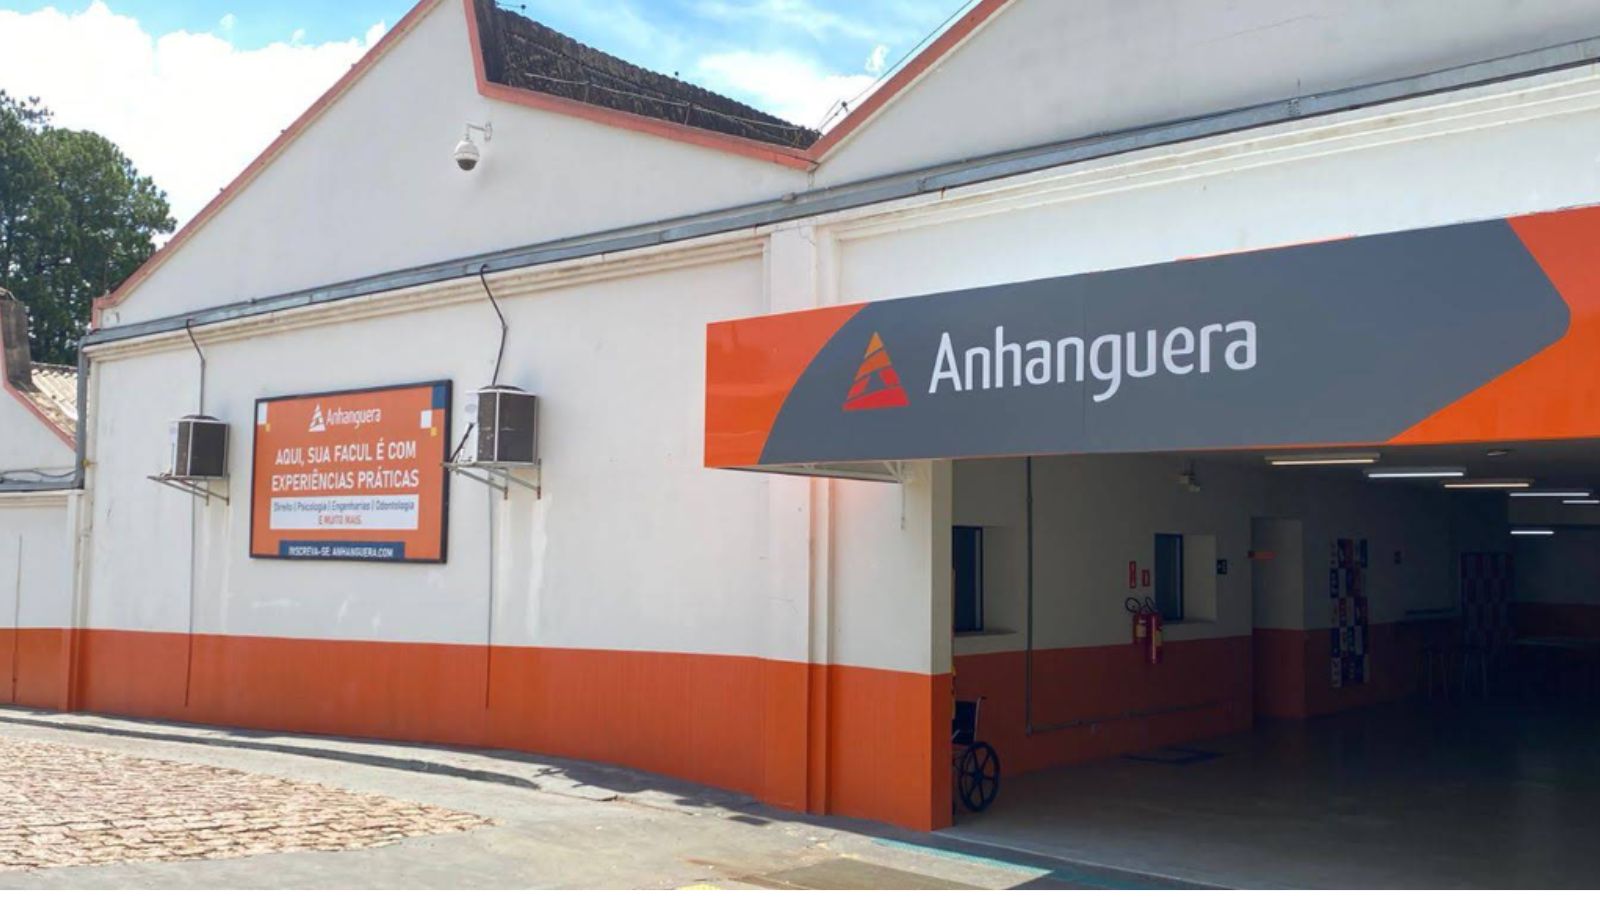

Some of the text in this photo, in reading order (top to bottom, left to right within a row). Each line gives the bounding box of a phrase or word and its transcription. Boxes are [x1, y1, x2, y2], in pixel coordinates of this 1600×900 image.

[928, 320, 1257, 403] Anhanguera
[326, 407, 381, 429] Anhanguera
[275, 438, 416, 466] AQUI, SUA FACUL É COM
[272, 466, 419, 491] EXPERIÊNCIAS PRÁTICAS
[297, 502, 327, 513] Psicologia
[375, 500, 415, 512] Odontologia
[332, 546, 394, 558] ANHANGUERA.COM
